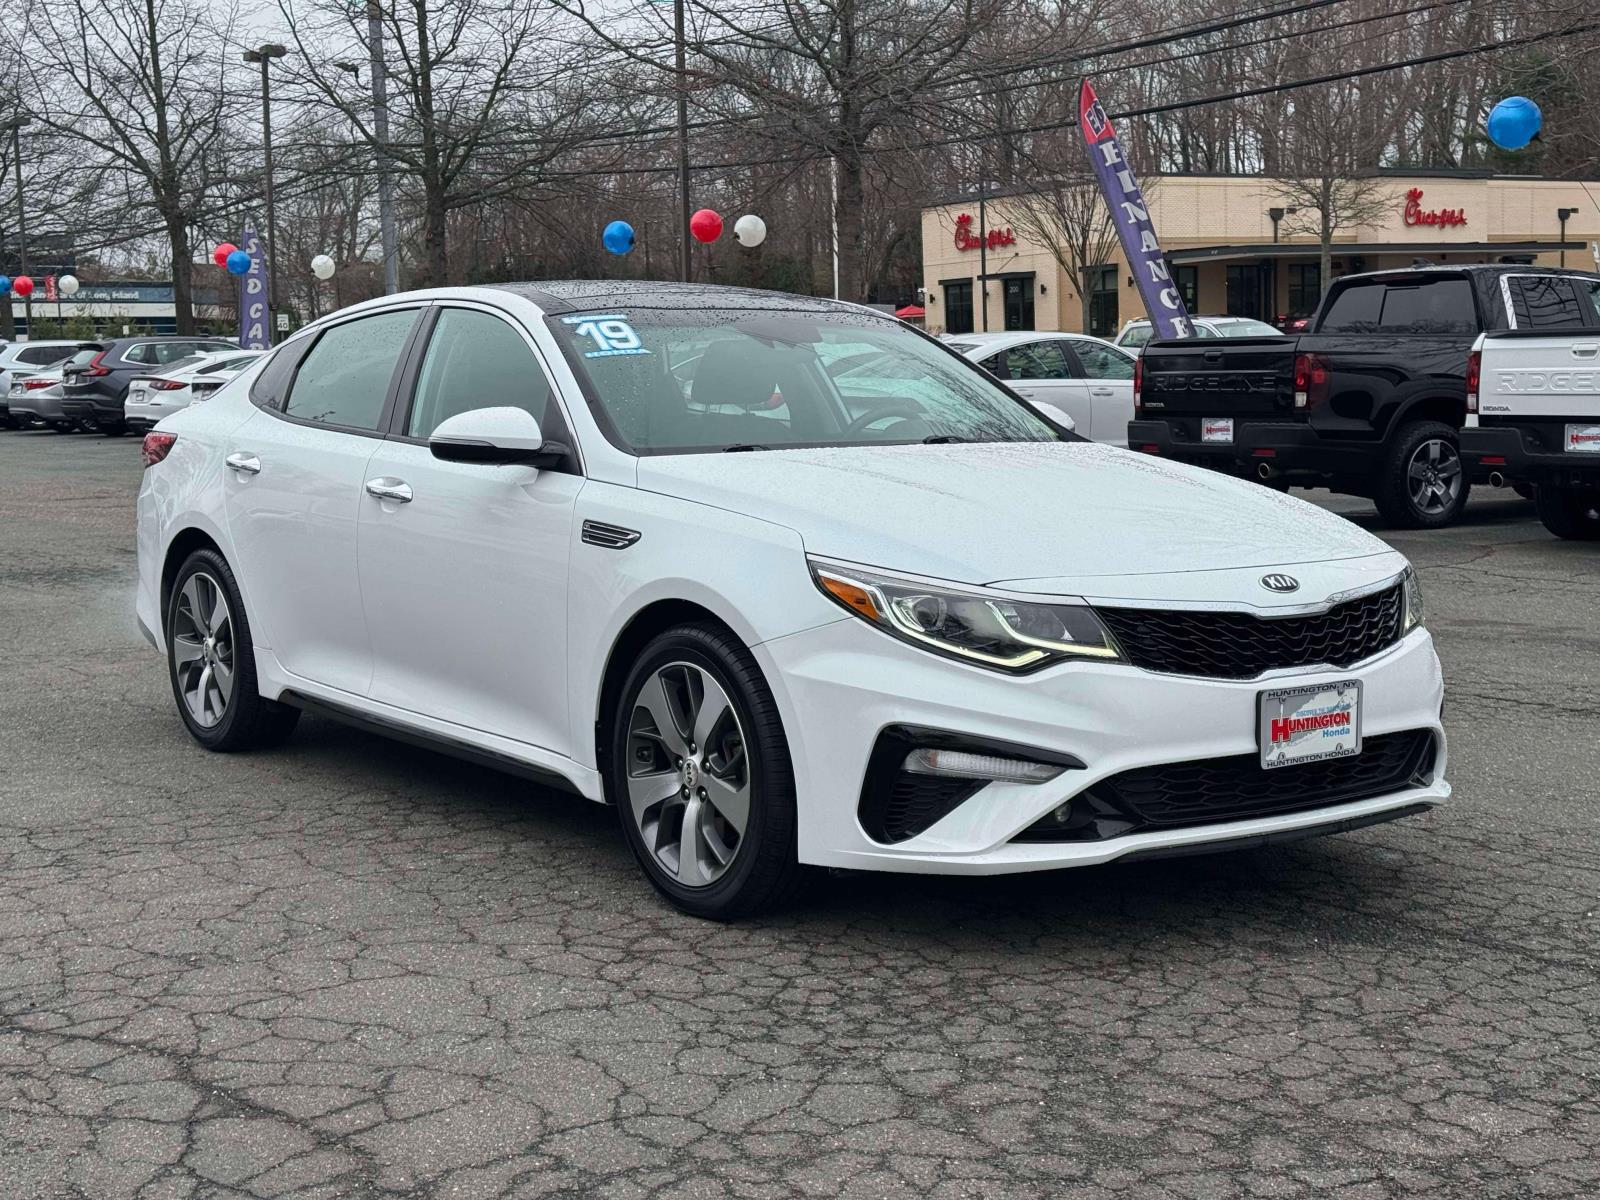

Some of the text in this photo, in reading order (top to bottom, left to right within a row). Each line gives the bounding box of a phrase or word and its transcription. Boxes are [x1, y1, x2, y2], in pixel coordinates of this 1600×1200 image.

[1099, 141, 1190, 339] FINANCE
[112, 289, 140, 299] Island
[575, 320, 642, 351] 19
[1264, 575, 1298, 588] KIA
[1322, 727, 1350, 738] Honda
[1266, 749, 1356, 768] HUNTINGTON HONDA
